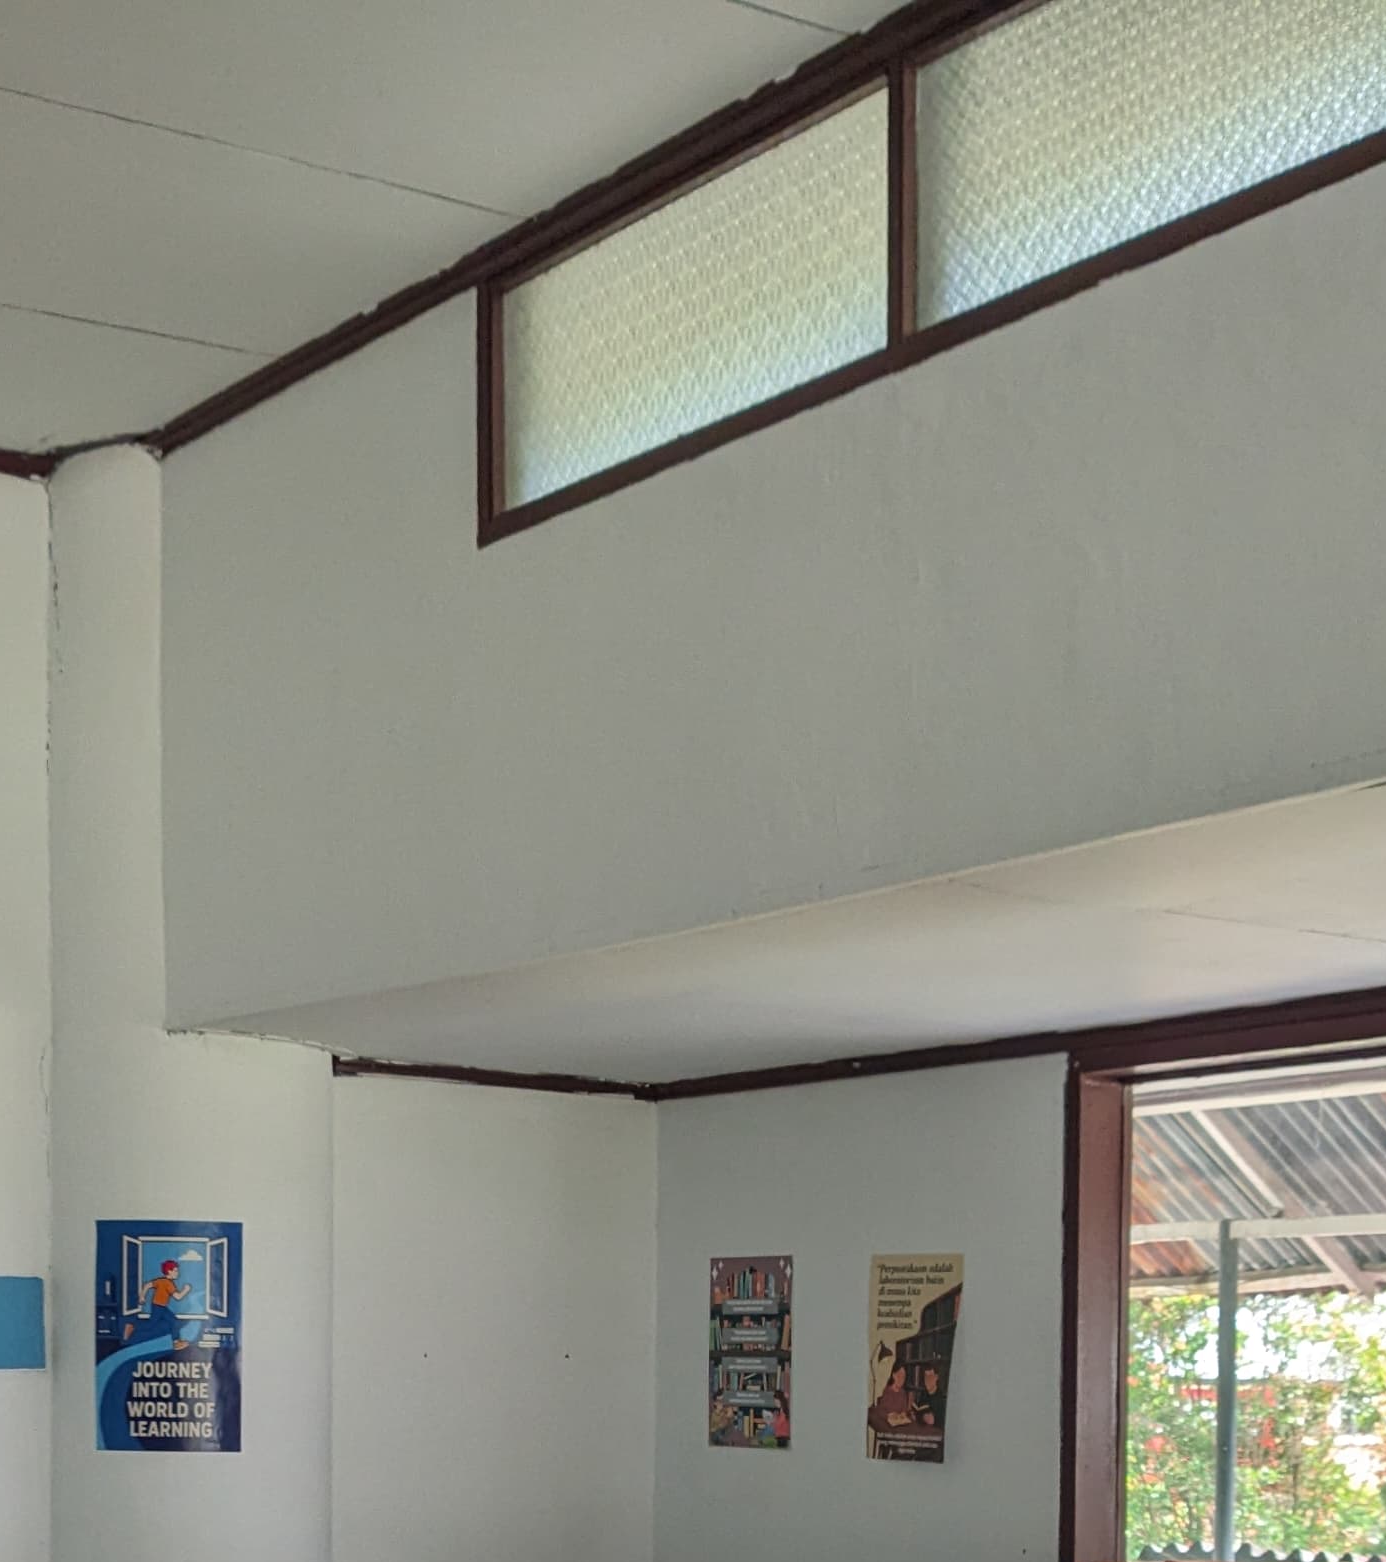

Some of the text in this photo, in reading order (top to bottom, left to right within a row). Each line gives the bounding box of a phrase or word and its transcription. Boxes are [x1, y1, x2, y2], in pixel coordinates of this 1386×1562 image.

[132, 1361, 213, 1379] JOURNEY
[132, 1382, 209, 1399] INTO THE
[127, 1401, 215, 1418] WORLD OF
[129, 1421, 213, 1438] LEARNING
